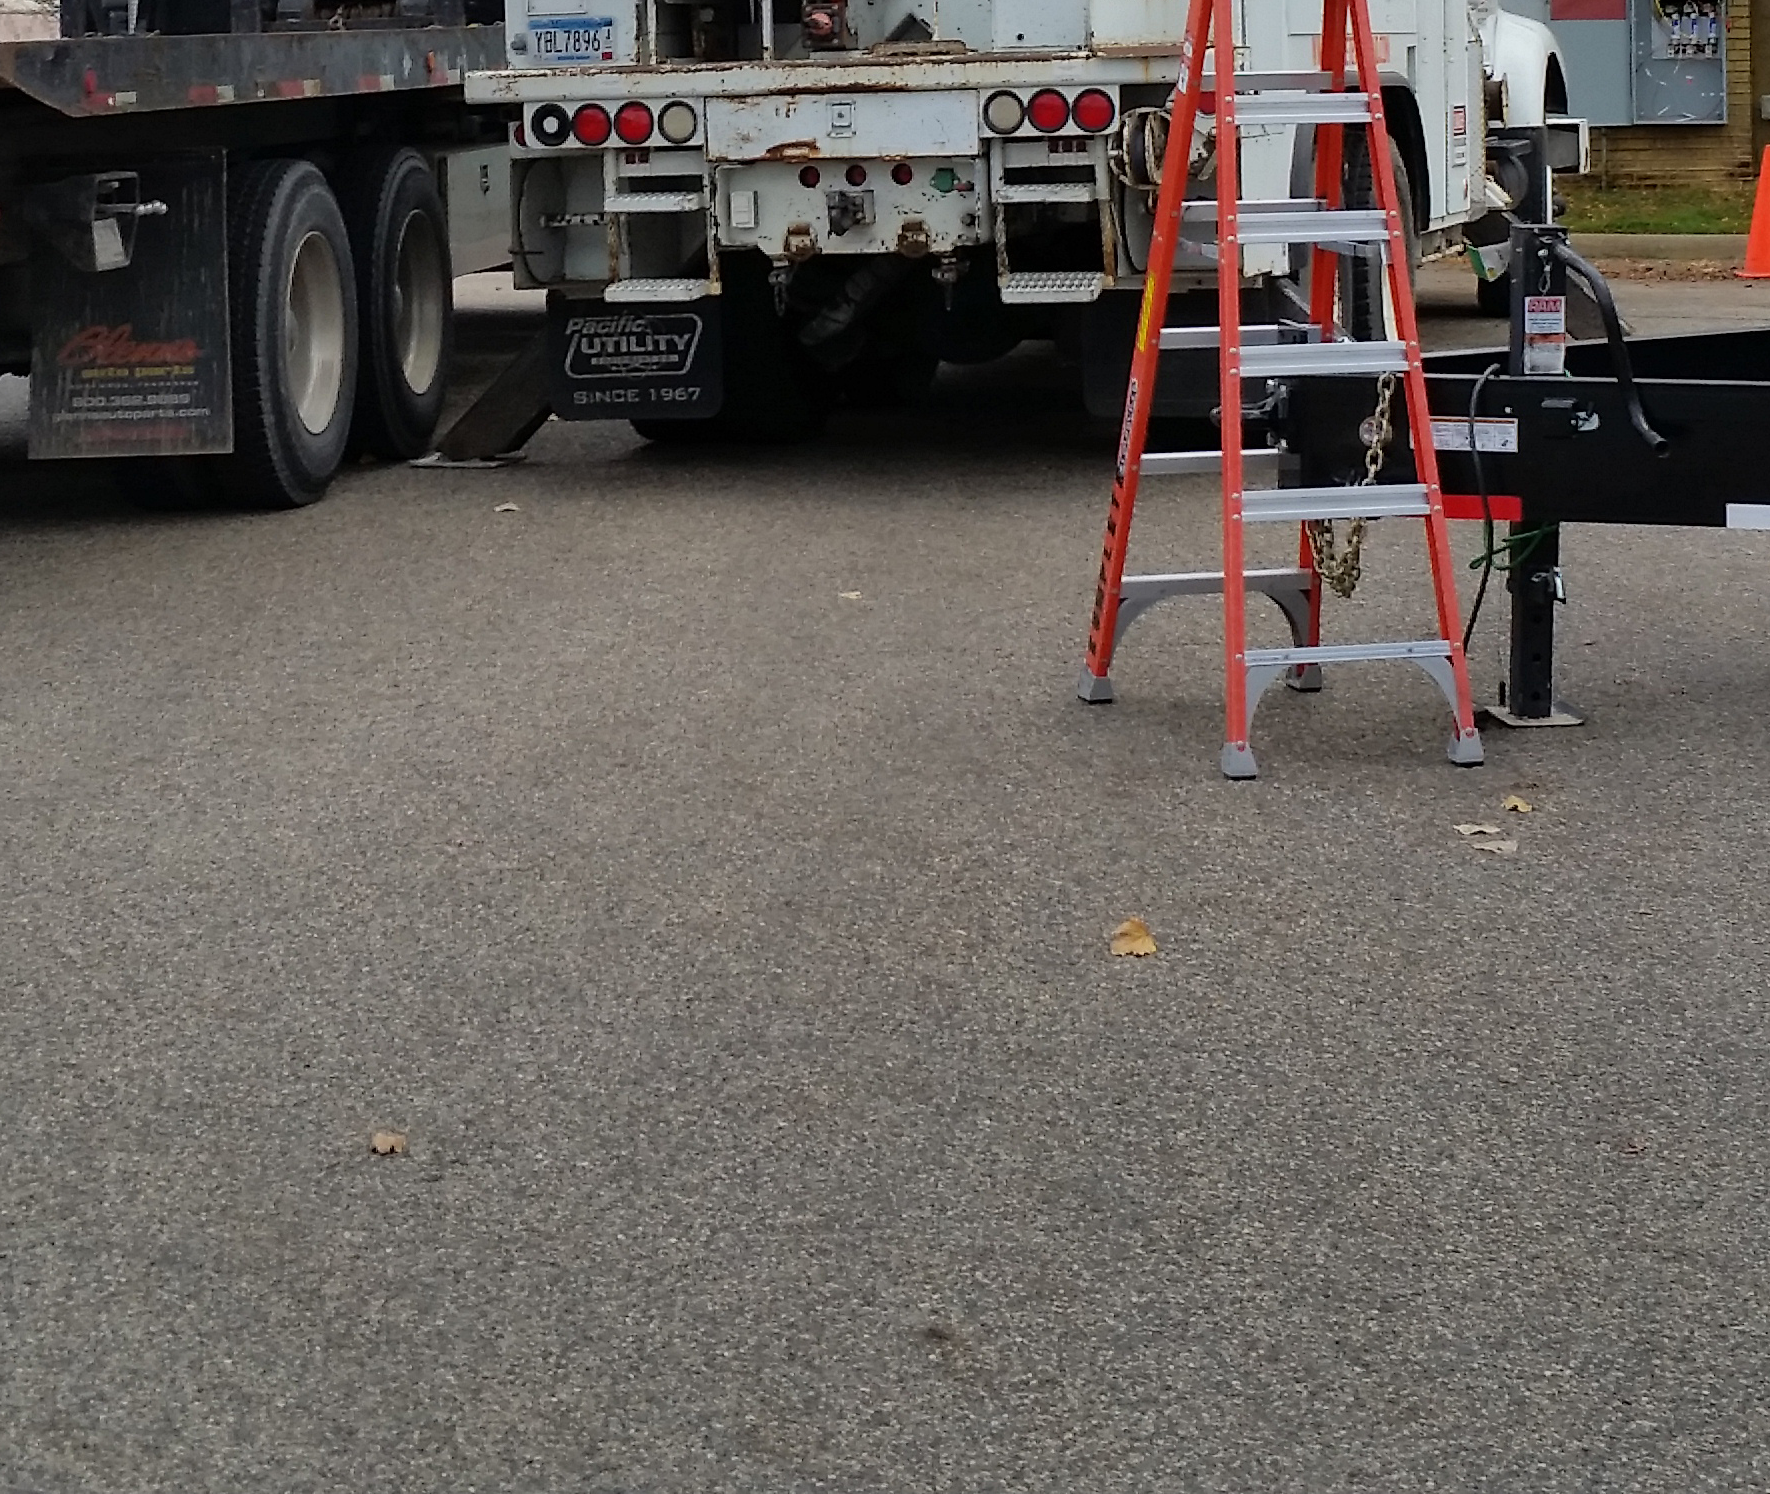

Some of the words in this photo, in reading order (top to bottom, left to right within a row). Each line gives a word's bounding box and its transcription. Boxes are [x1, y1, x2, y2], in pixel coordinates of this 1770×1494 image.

[534, 29, 601, 54] YBL7896
[565, 315, 648, 335] Pacific
[581, 333, 692, 354] UTILITY
[573, 388, 640, 404] SINCE
[648, 386, 701, 402] 1967
